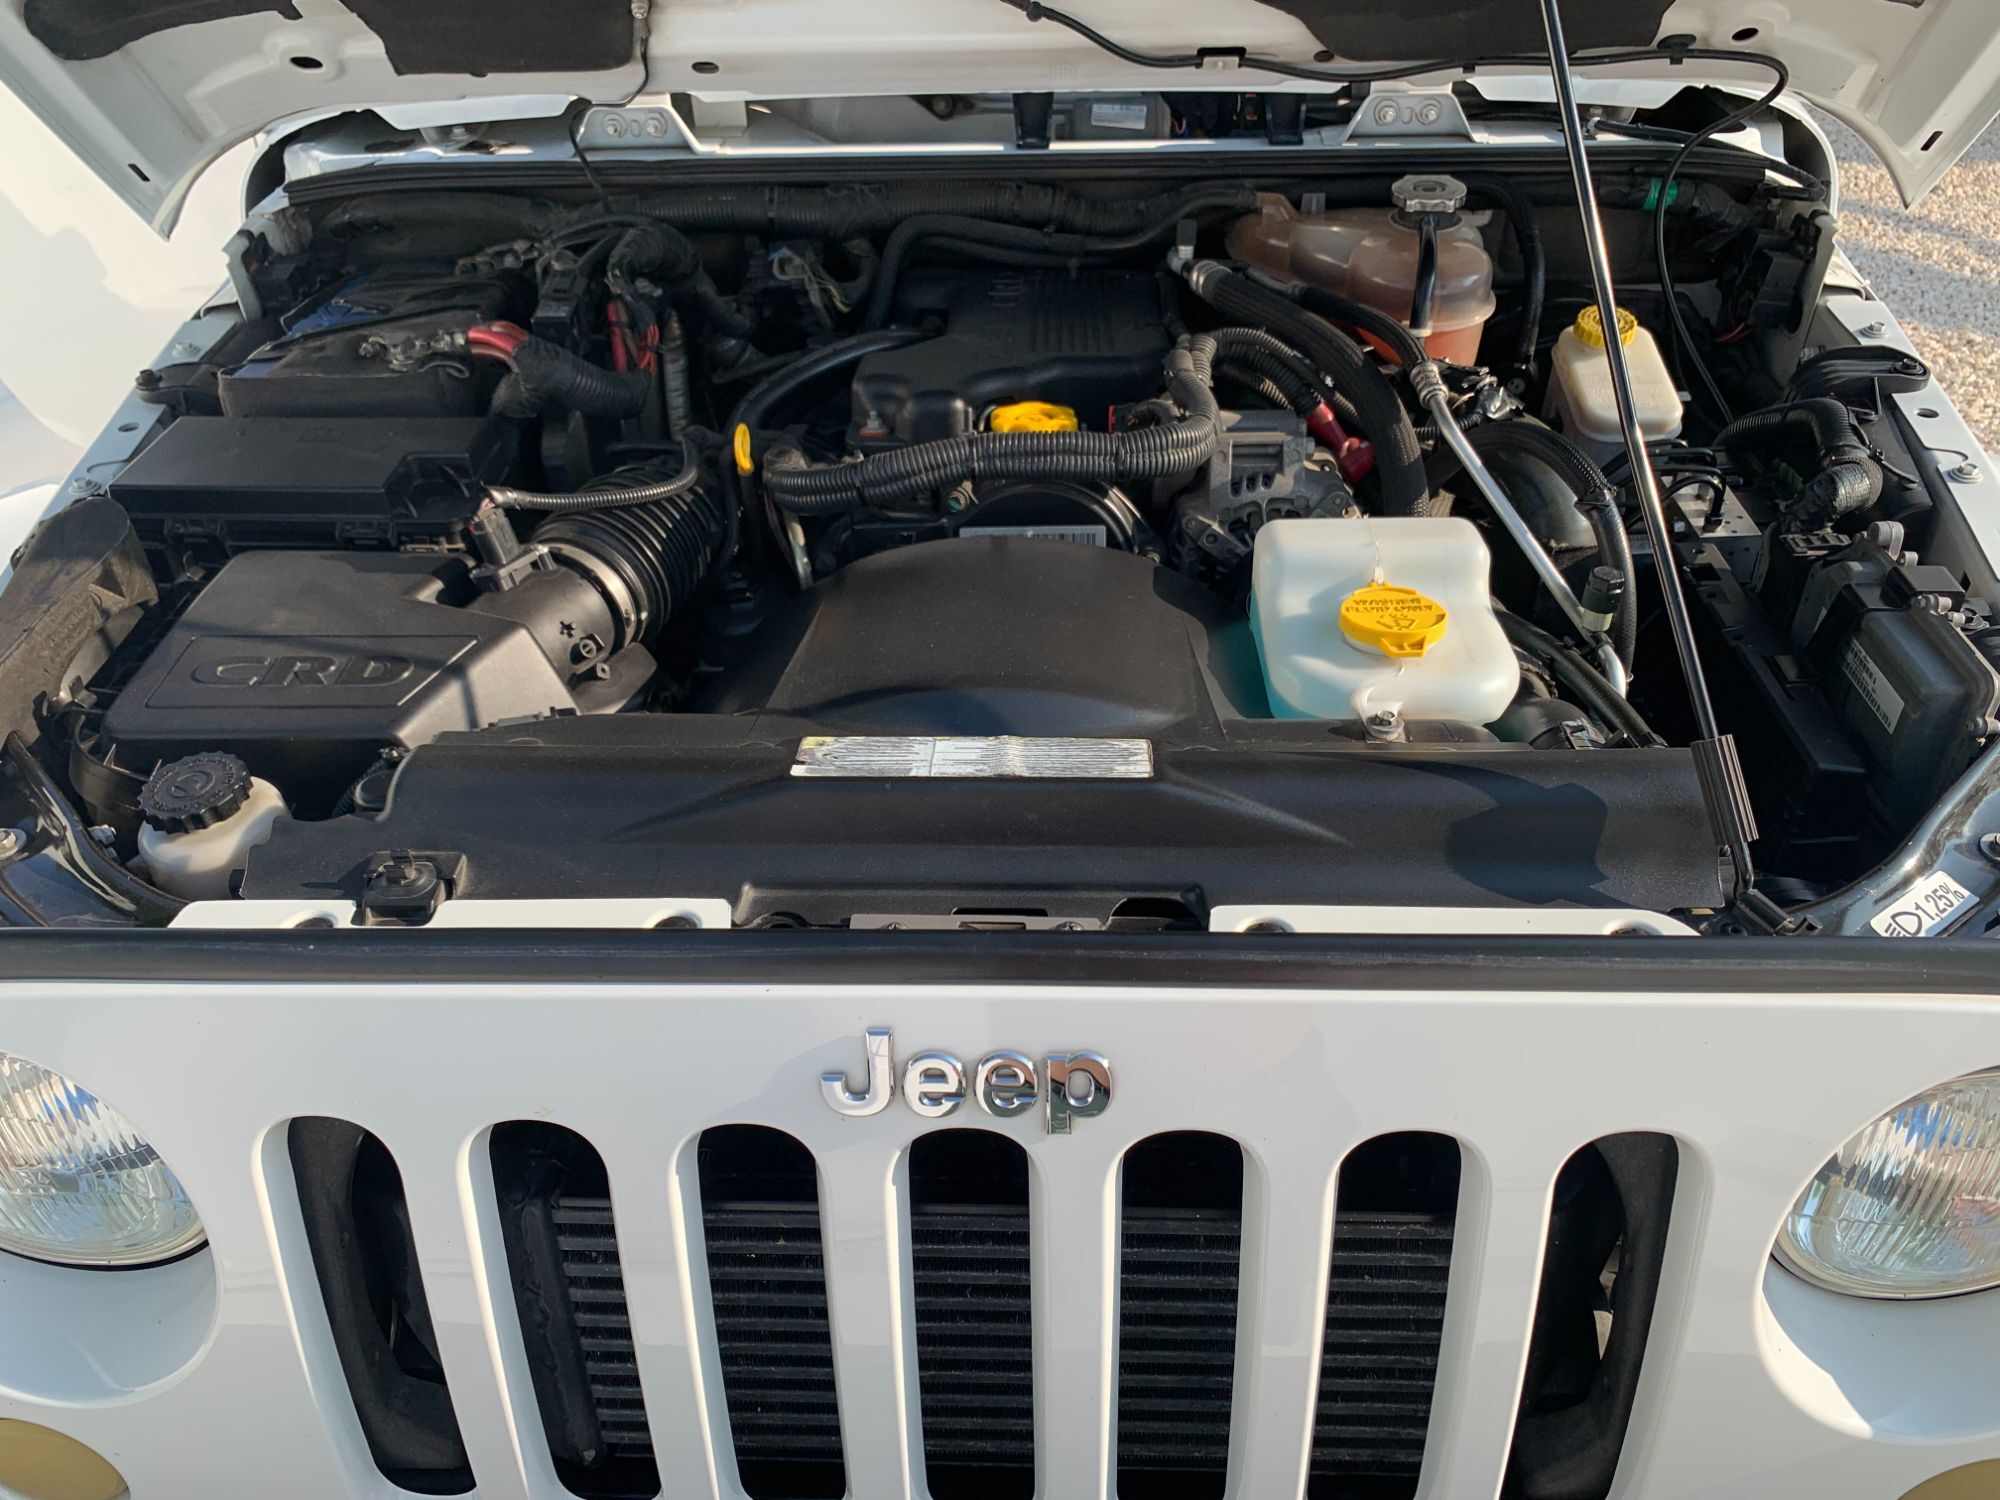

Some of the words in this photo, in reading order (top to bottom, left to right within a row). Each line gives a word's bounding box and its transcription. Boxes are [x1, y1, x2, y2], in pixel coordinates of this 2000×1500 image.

[191, 656, 414, 687] CRD
[1914, 881, 1965, 920] 1,25%
[820, 1027, 1112, 1134] Jeep
